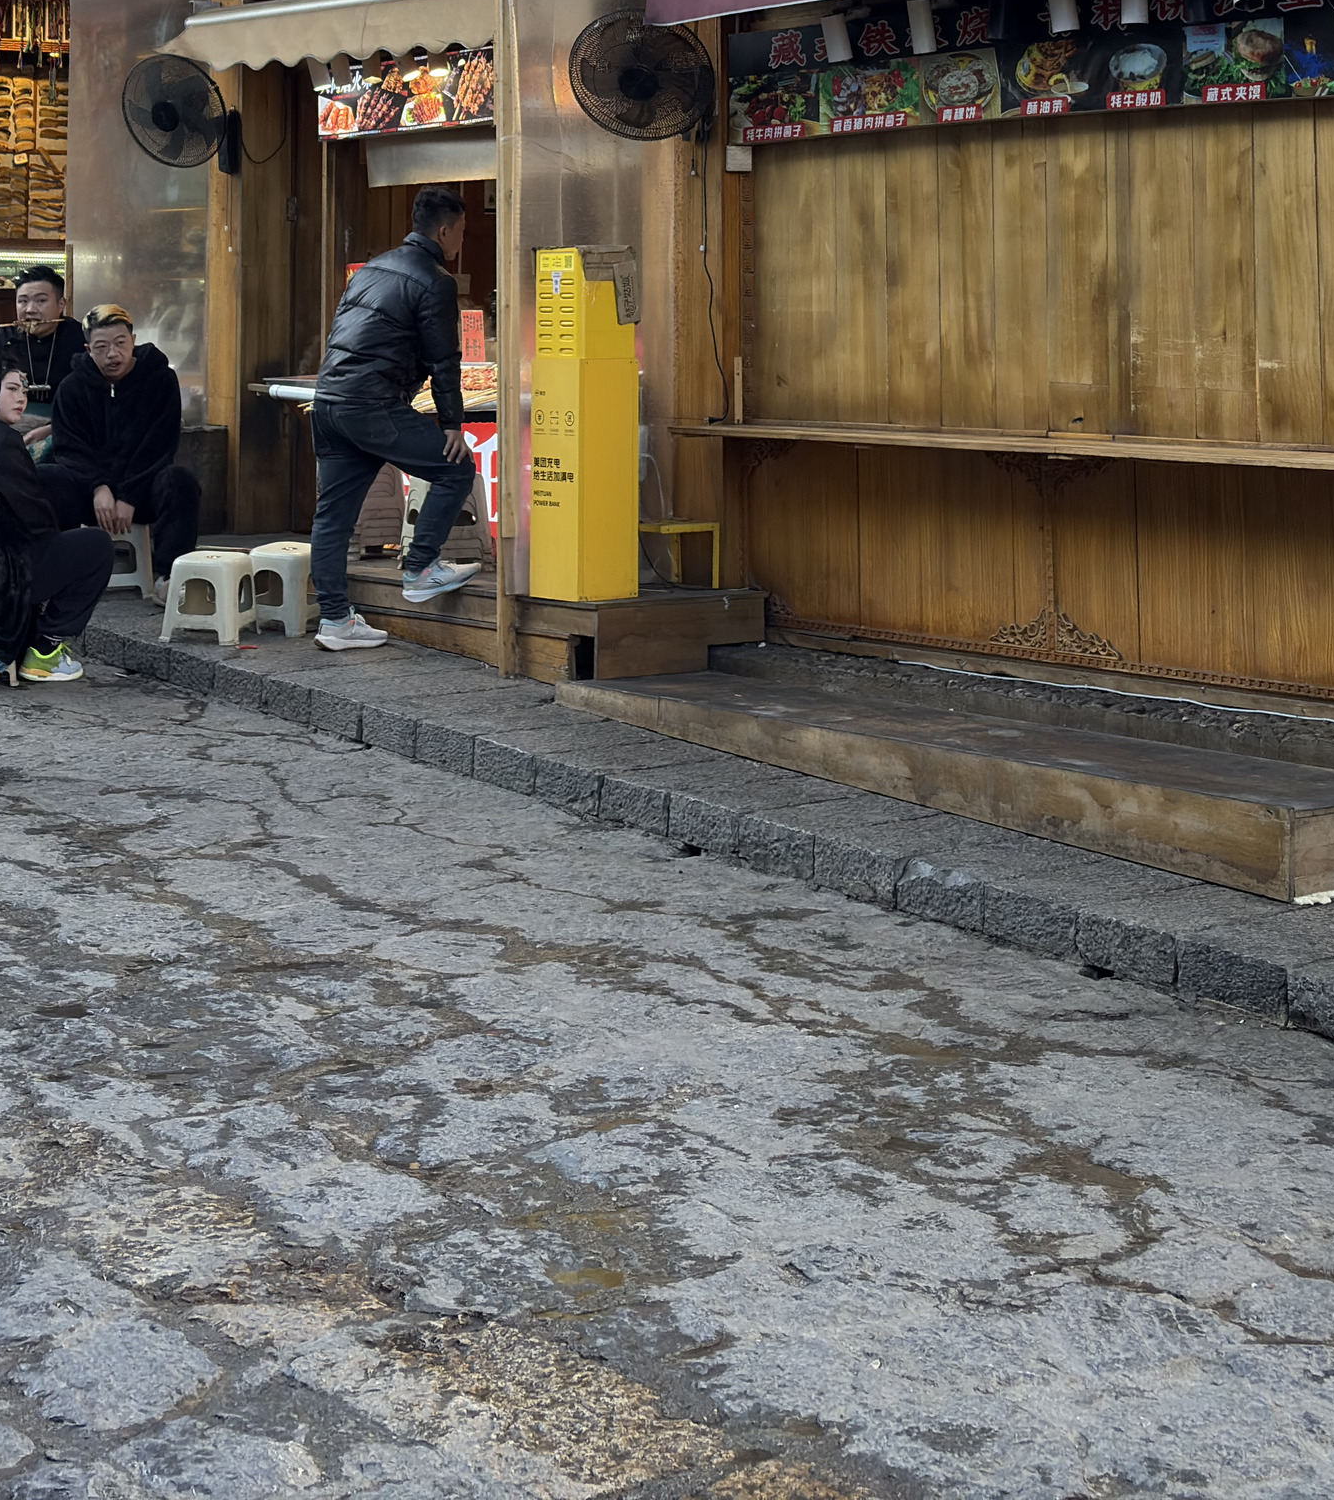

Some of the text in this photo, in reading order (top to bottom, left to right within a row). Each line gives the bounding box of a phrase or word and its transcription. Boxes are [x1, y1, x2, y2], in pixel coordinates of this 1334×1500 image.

[1110, 93, 1163, 108] 牦牛酸奶
[1206, 86, 1262, 101] 藏式夹馍
[942, 106, 977, 121] 青稞饼
[1026, 100, 1064, 114] 酥油茶
[833, 113, 907, 133] 藏香猪肉拼菌子
[746, 124, 802, 141] 牦牛肉拼菌子
[533, 457, 560, 468] 美团充电
